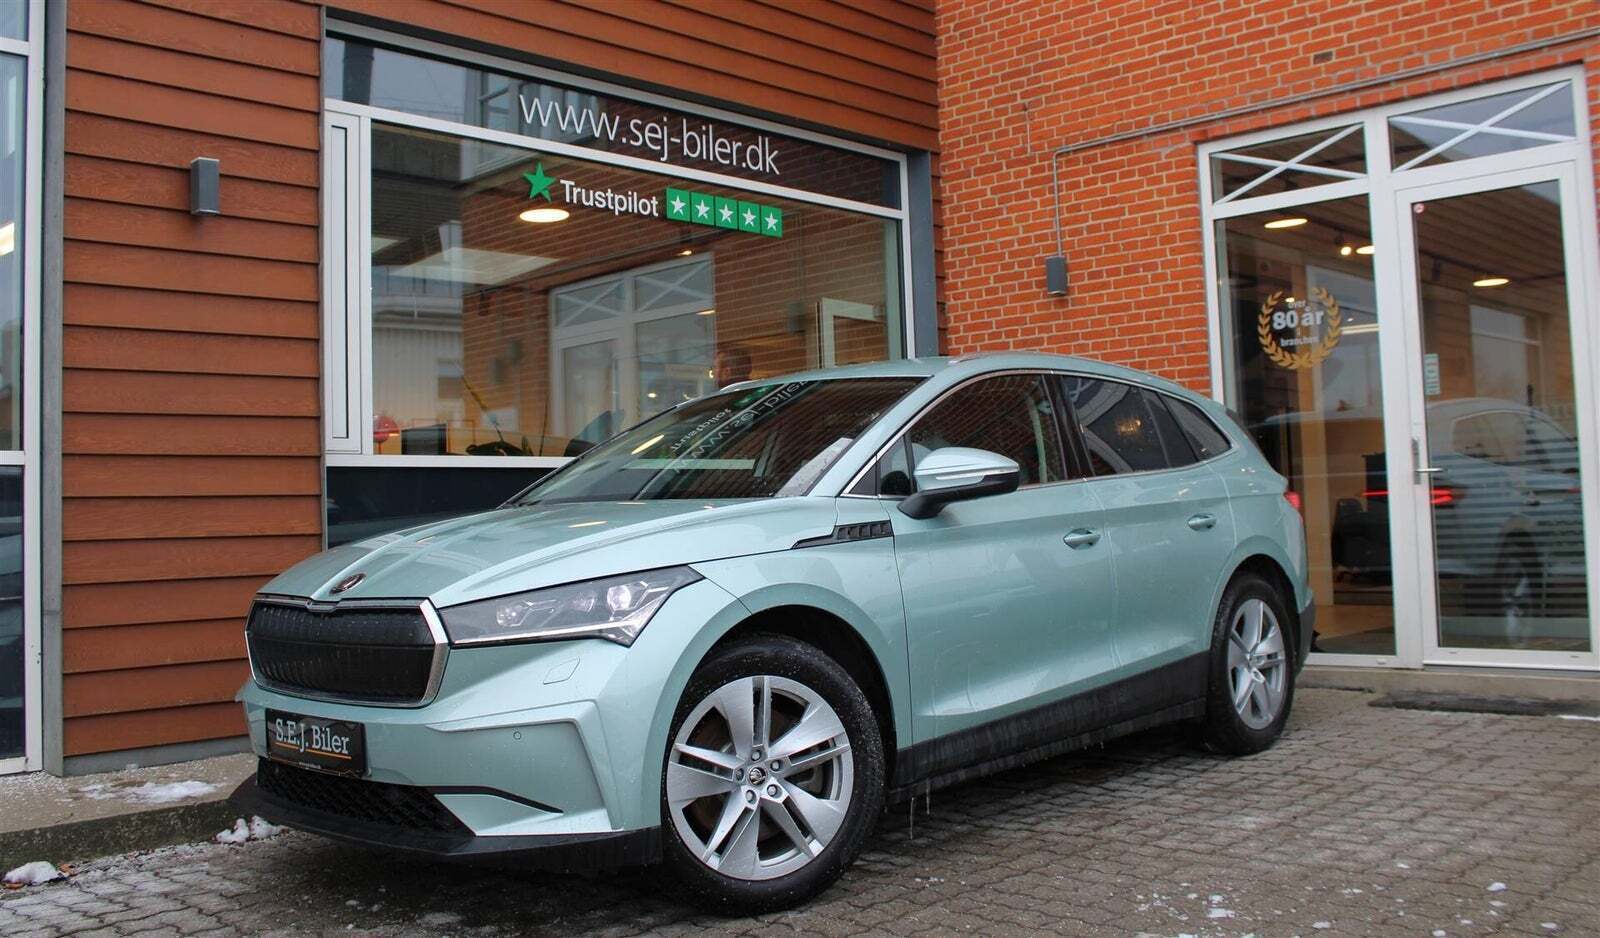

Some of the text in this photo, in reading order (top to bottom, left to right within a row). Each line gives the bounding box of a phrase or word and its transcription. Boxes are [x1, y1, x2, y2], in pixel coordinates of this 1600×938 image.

[519, 94, 780, 175] www.sej-biler.dk
[560, 178, 659, 217] Trustpilot
[1273, 305, 1324, 330] 80 år
[275, 718, 350, 754] S.E.J. Biler
